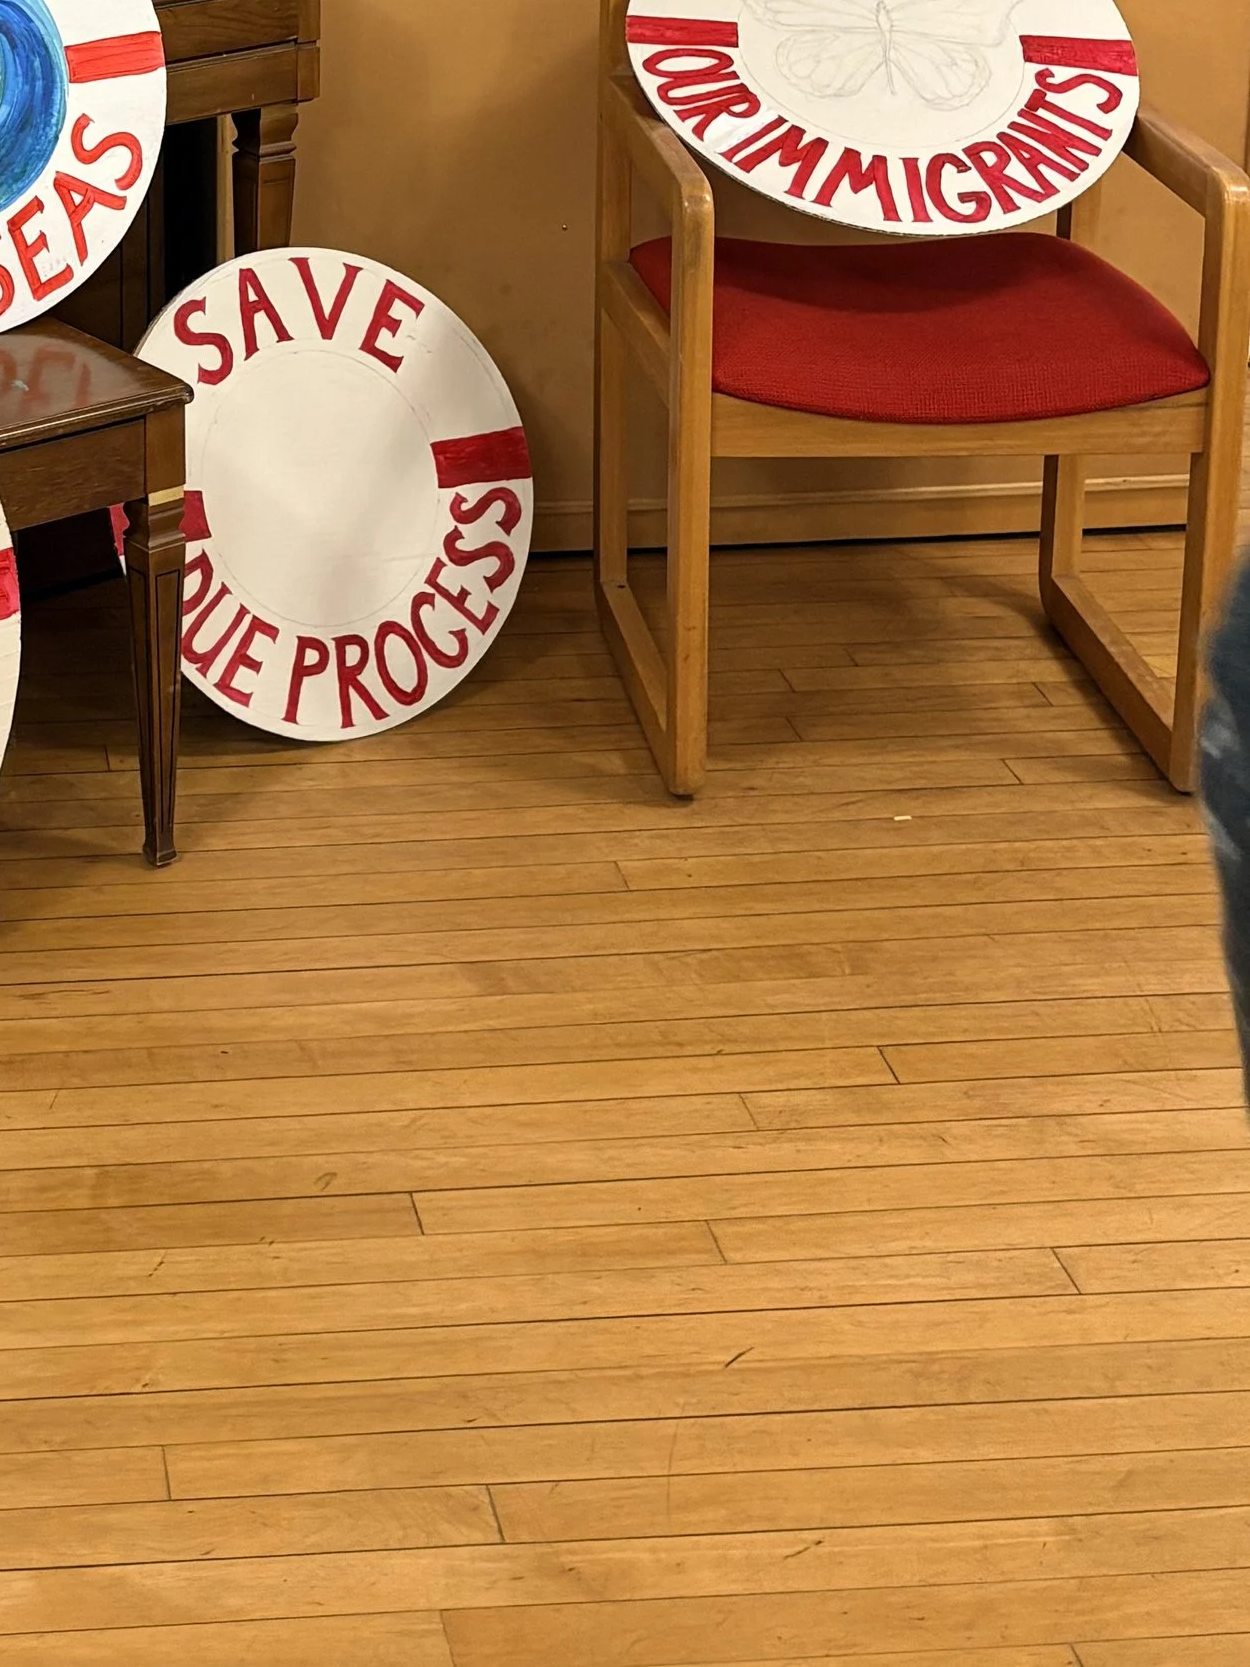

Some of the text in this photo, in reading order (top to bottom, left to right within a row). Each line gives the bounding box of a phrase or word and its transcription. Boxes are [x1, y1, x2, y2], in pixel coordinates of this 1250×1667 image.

[642, 48, 1122, 223] OUR IMMIGRANTS
[173, 257, 425, 385] SAVE
[181, 487, 522, 729] DUE PROCESS
